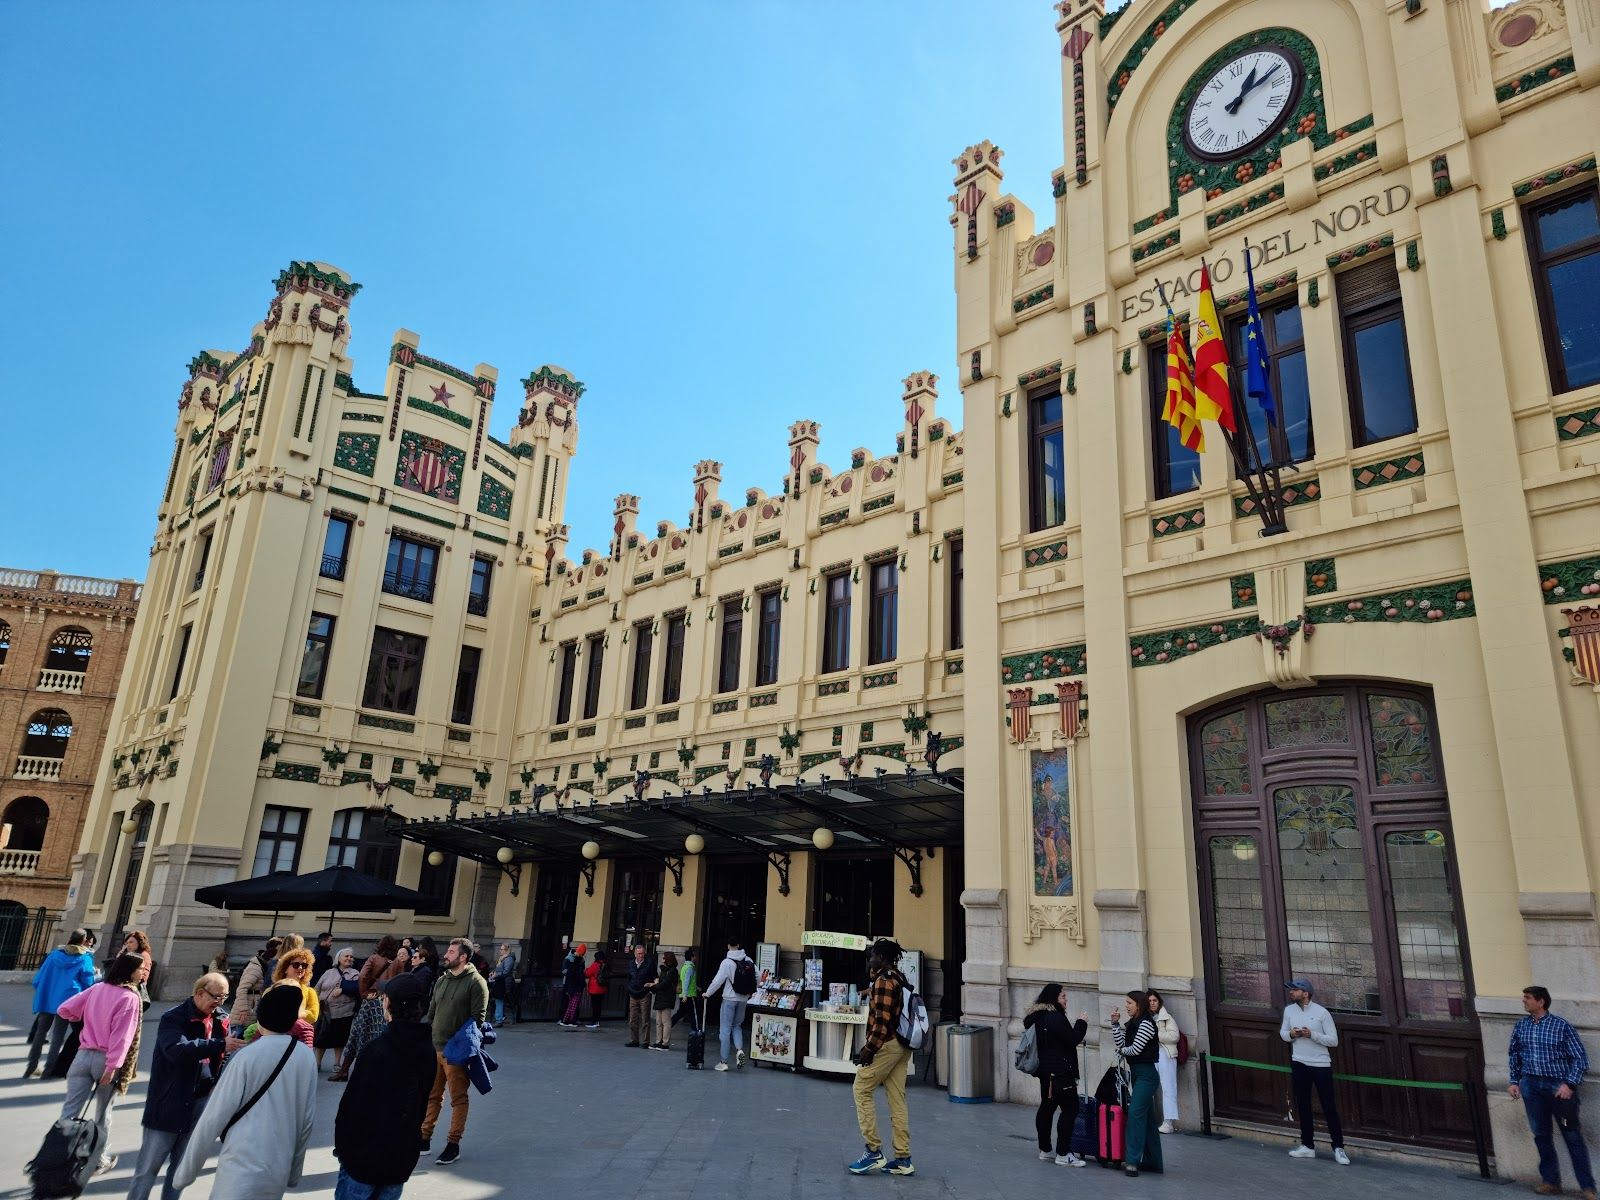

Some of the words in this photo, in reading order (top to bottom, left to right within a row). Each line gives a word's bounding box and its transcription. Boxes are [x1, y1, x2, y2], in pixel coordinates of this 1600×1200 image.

[1229, 63, 1243, 80] XII
[1209, 78, 1225, 93] XI
[1271, 75, 1286, 89] III
[1199, 100, 1212, 108] X
[1267, 94, 1283, 108] IIII
[1195, 116, 1208, 130] IX
[1257, 117, 1268, 127] V
[1199, 127, 1216, 145] VIII
[1214, 133, 1229, 147] VII
[1236, 129, 1248, 143] VI
[1242, 229, 1306, 273] DEL
[1312, 183, 1411, 245] NORD
